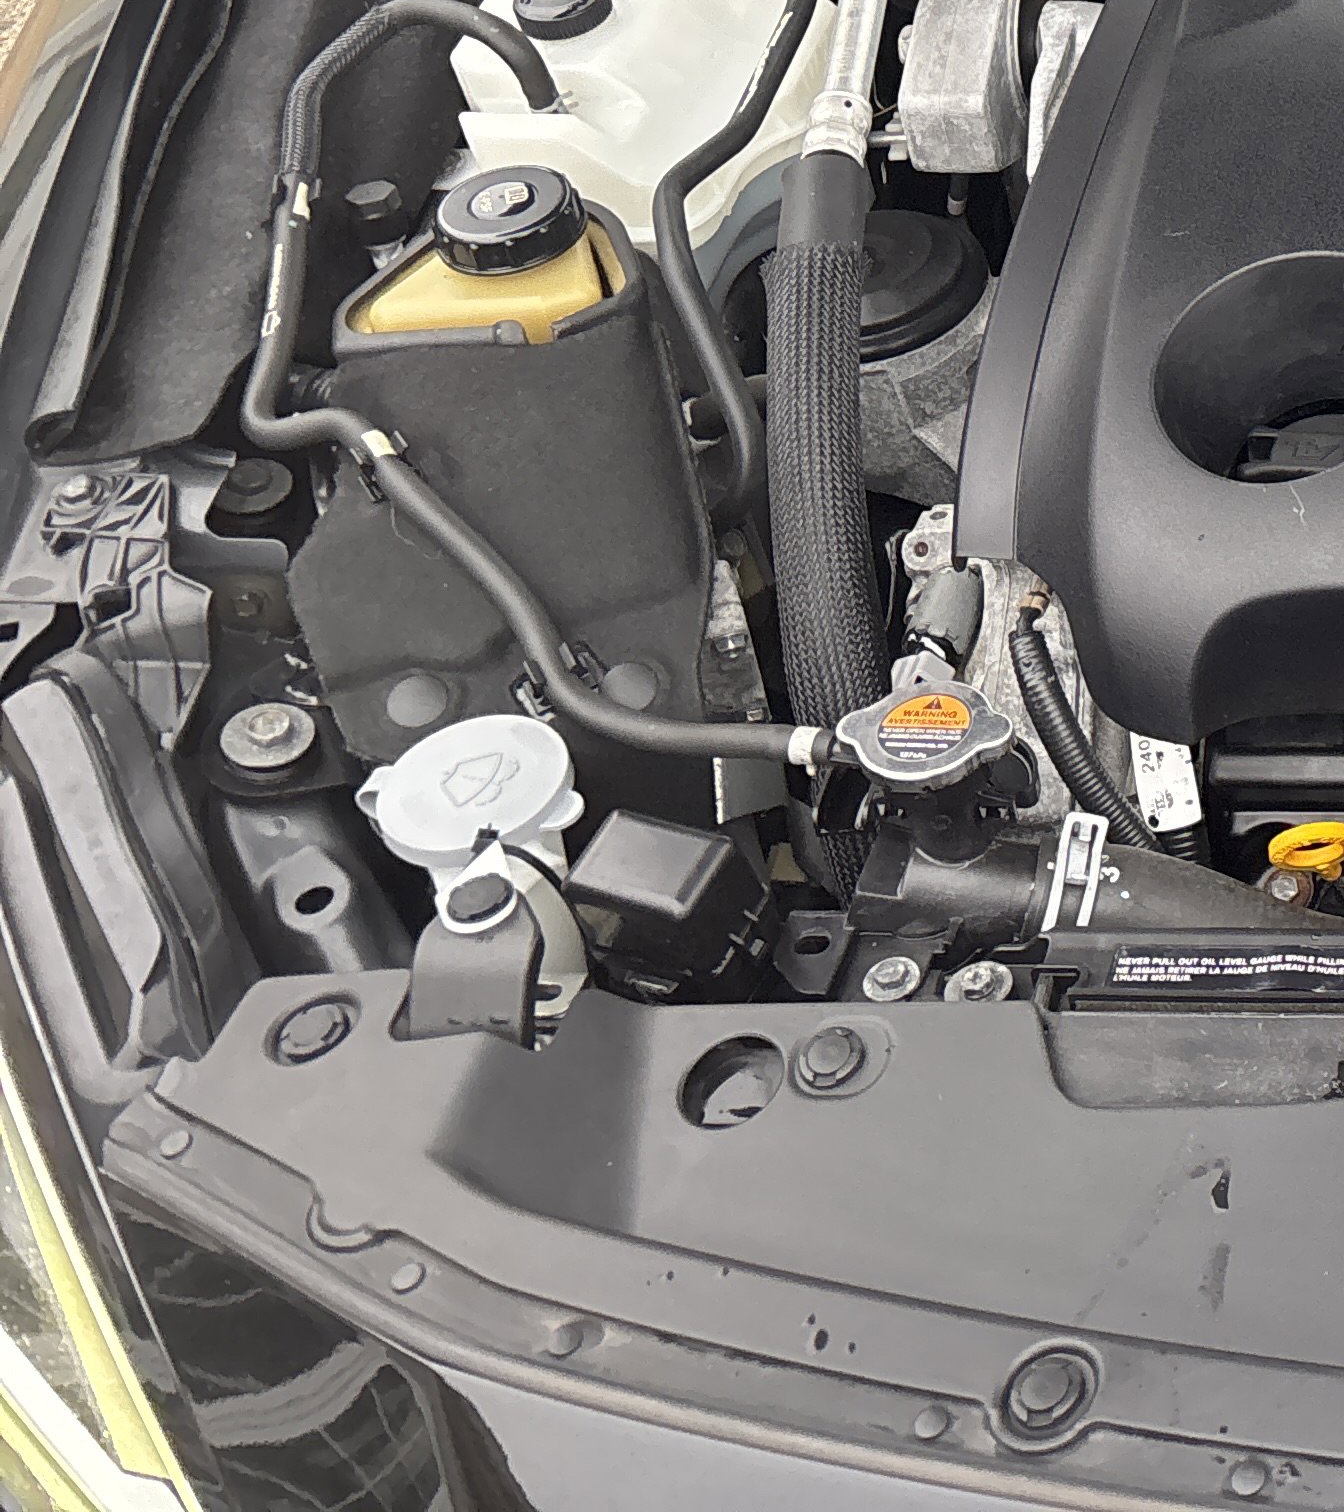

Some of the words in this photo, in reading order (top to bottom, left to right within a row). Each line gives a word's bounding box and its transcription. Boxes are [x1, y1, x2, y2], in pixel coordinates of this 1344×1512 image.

[904, 710, 958, 718] WARNING
[887, 718, 966, 726] AVERTISSEMENT
[1118, 957, 1150, 965] NEVER
[1152, 957, 1175, 965] PULL
[1250, 955, 1283, 965] GAUGE
[1255, 965, 1268, 973] DE
[1270, 963, 1305, 971] NIVEAU
